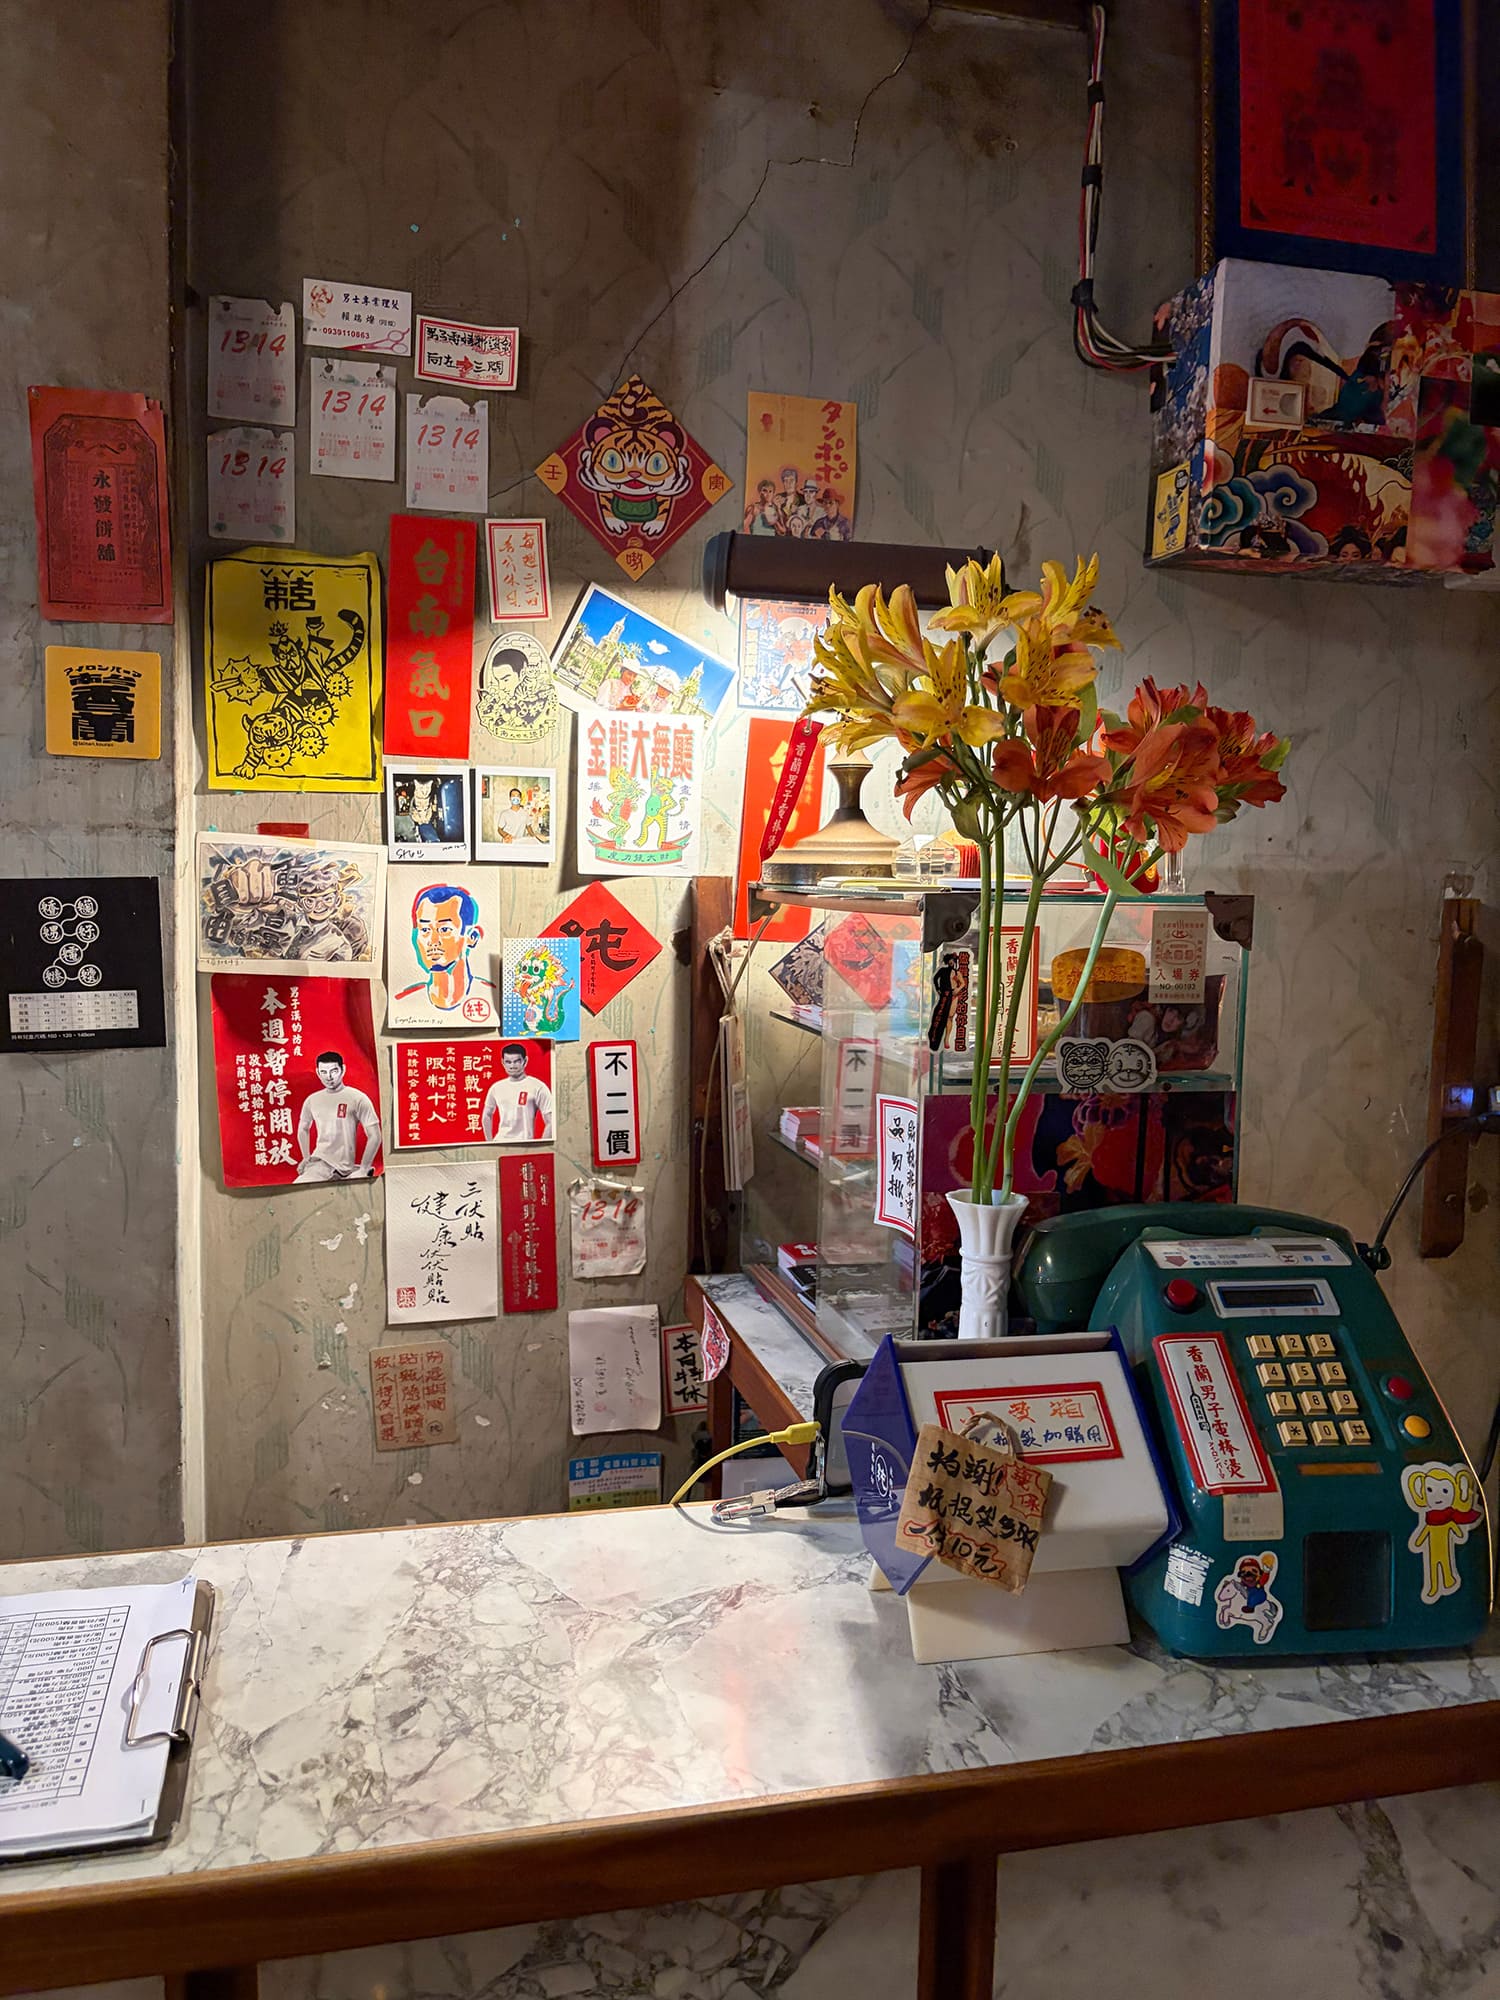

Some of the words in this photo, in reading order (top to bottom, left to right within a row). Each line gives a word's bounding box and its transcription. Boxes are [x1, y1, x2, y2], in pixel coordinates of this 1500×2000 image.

[220, 329, 249, 353] 13
[321, 389, 352, 413] 13
[357, 393, 387, 416] 14
[417, 424, 446, 447] 13
[452, 427, 480, 449] 14
[220, 451, 250, 476] 13
[257, 456, 287, 479] 14
[408, 538, 451, 738] 台南氣口
[586, 719, 694, 781] 金龍大舞廳
[260, 986, 298, 1167] 本週暫停開放
[426, 1057, 448, 1123] 限制十人
[462, 1055, 484, 1134] 配戴口罩
[604, 1051, 631, 1156] 不二價
[455, 1181, 485, 1242] 三伏貼
[581, 1200, 608, 1222] 13
[611, 1198, 639, 1220] 14
[1260, 1338, 1267, 1349] 1
[1289, 1337, 1298, 1348] 2
[1319, 1337, 1328, 1348] 3
[1270, 1366, 1279, 1377] 4
[1301, 1365, 1309, 1376] 5
[1331, 1365, 1340, 1376] 6
[1186, 1344, 1246, 1479] 香蘭男子電棒燙
[1280, 1395, 1288, 1406] 7
[1312, 1395, 1321, 1406] 8
[1342, 1394, 1351, 1405] 9
[1323, 1425, 1331, 1436] 0
